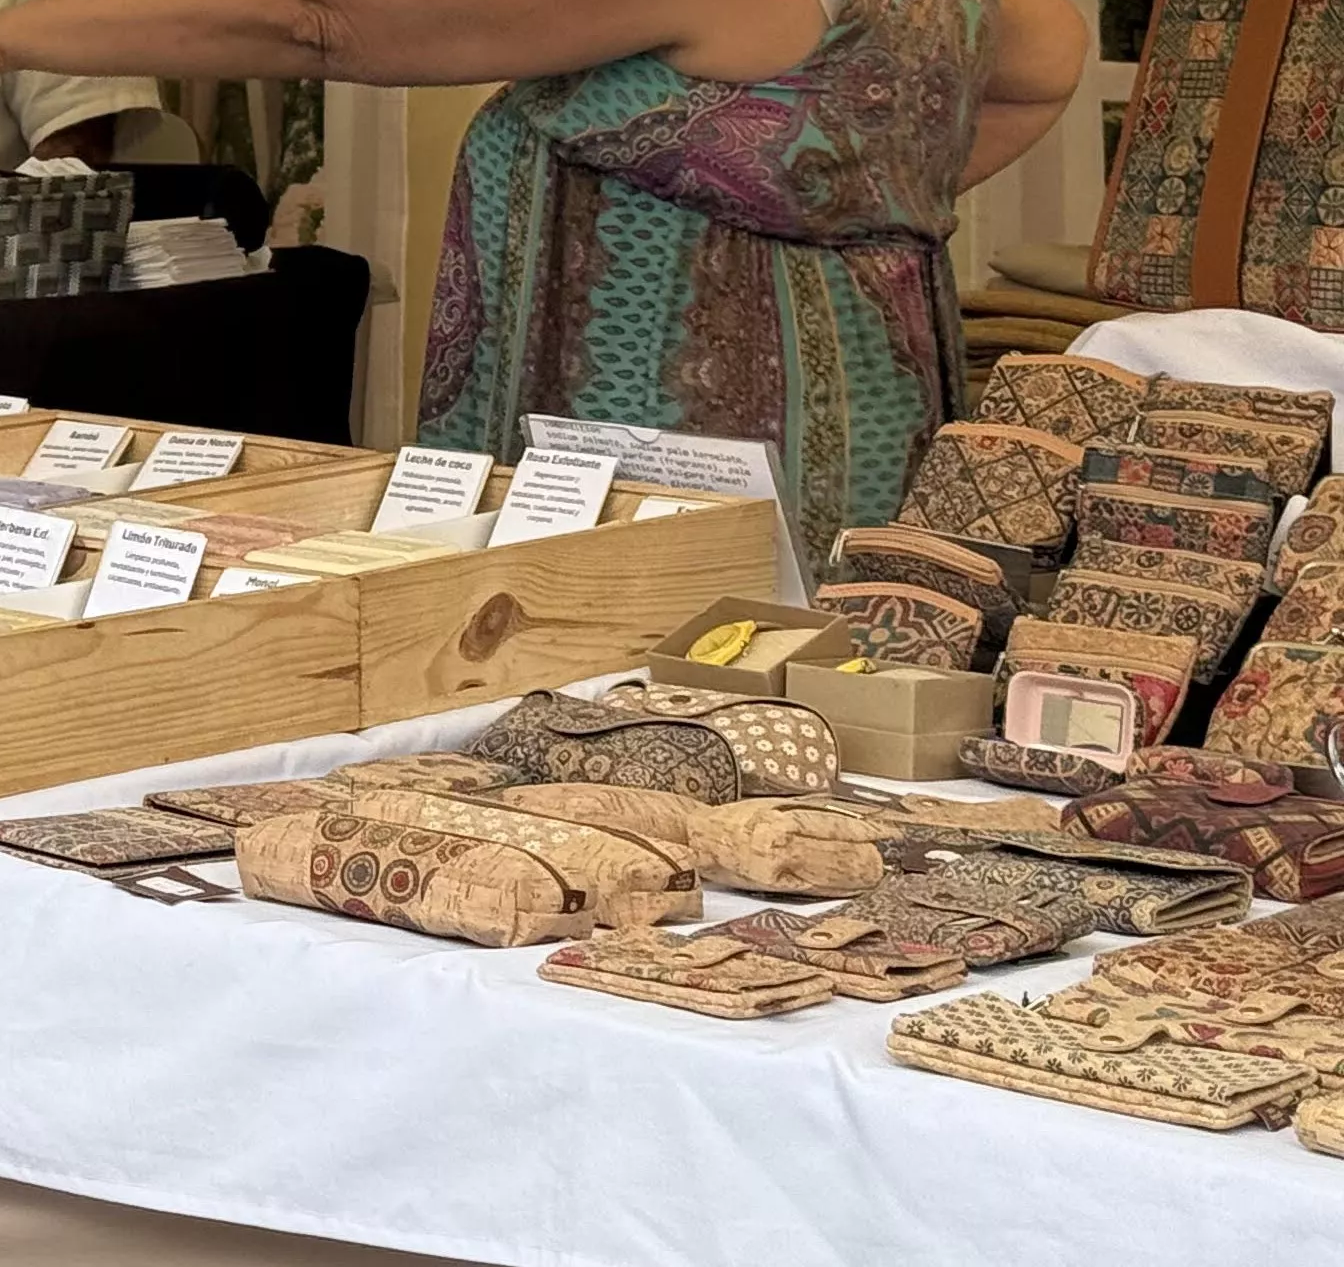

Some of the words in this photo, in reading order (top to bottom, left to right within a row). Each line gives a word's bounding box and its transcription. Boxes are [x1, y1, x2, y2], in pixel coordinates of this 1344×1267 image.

[405, 452, 433, 465] Leche
[434, 457, 447, 467] de
[448, 460, 472, 470] coco
